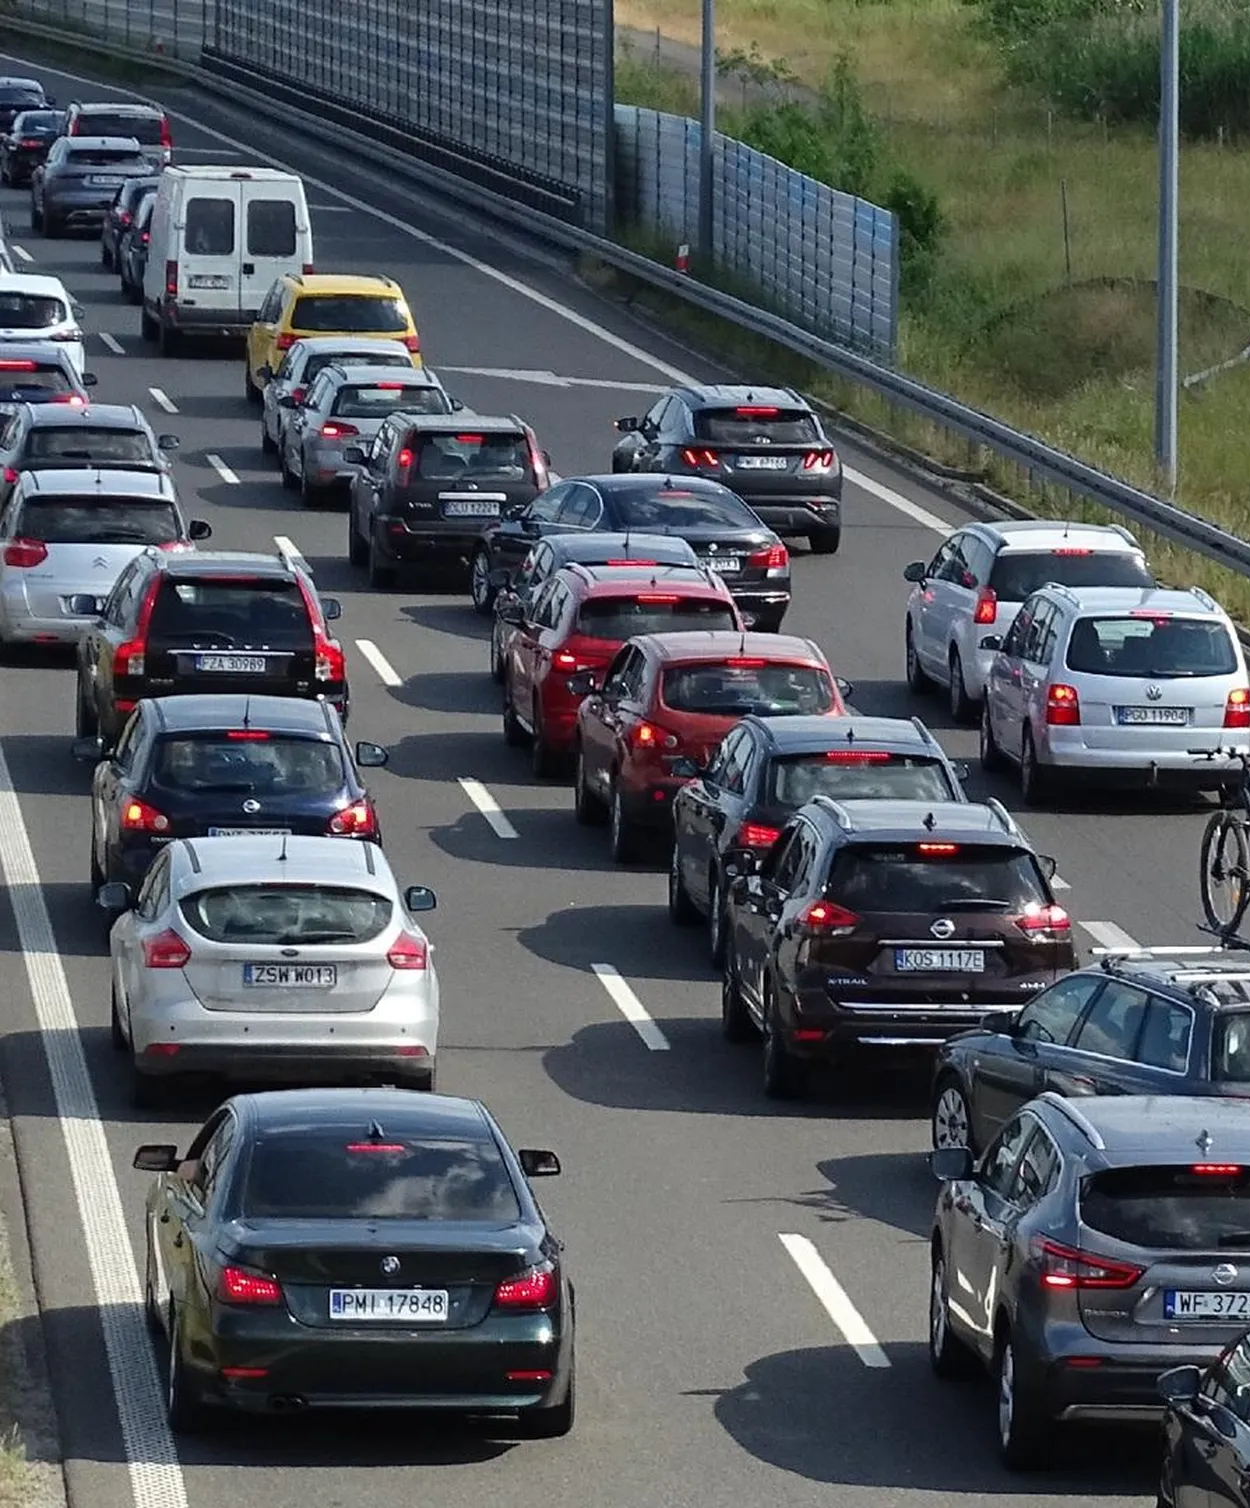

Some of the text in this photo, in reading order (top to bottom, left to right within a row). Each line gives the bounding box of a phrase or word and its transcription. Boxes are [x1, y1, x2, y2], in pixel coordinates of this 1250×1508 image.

[228, 658, 265, 671] 30989
[1125, 709, 1185, 721] PGO 11904
[905, 951, 982, 967] KOS 1117E
[254, 966, 333, 983] ZSW W013
[343, 1293, 444, 1314] PMI 17848
[1180, 1294, 1207, 1312] WF
